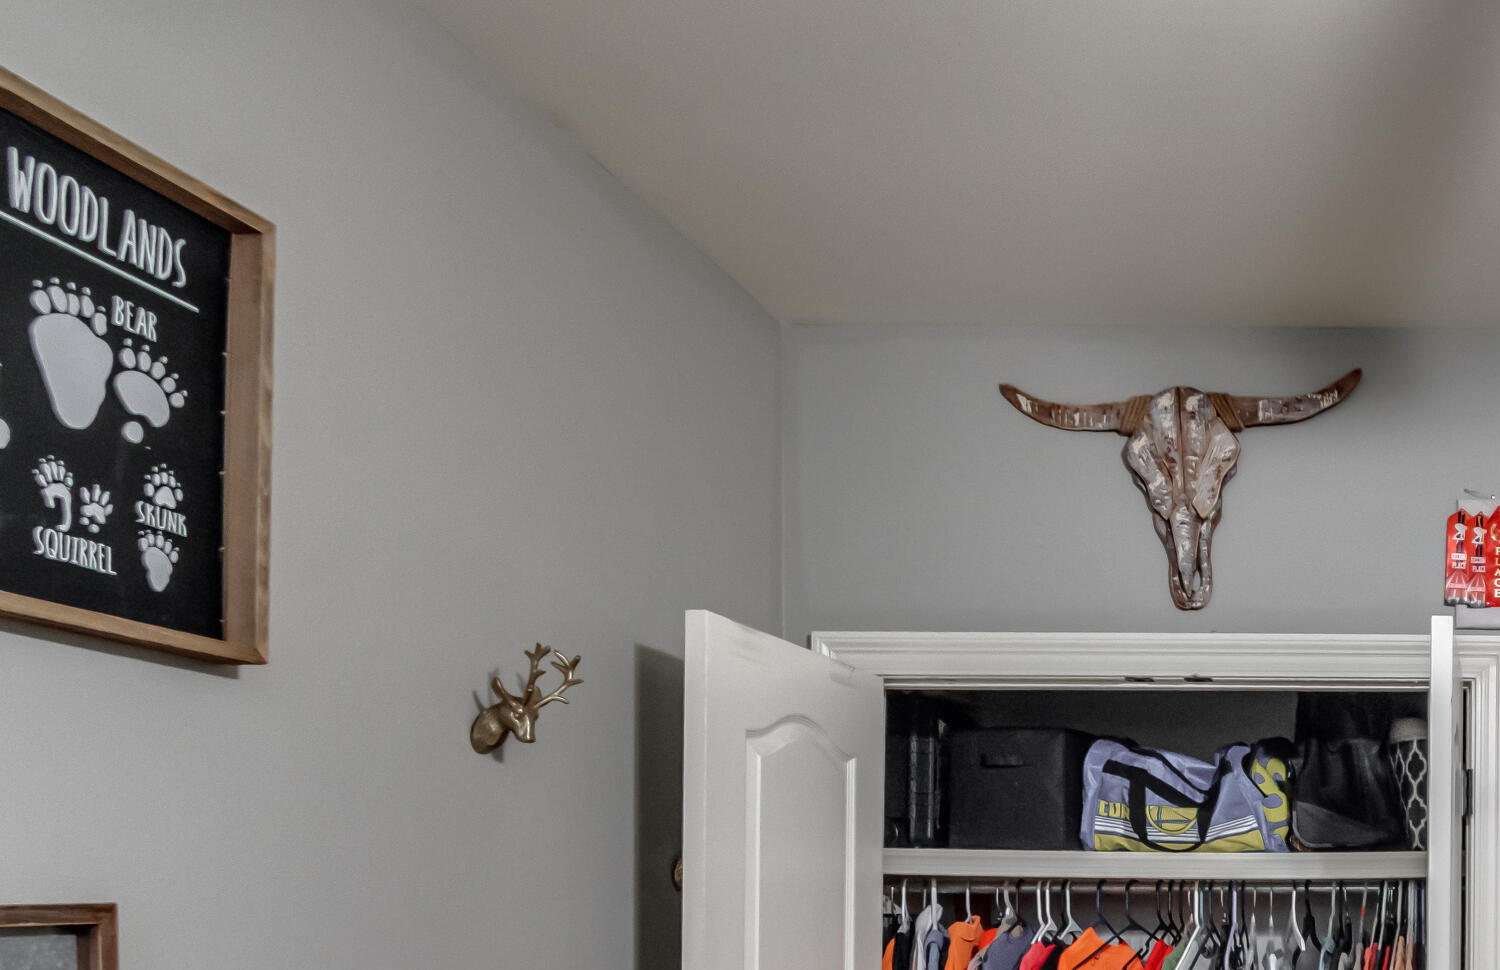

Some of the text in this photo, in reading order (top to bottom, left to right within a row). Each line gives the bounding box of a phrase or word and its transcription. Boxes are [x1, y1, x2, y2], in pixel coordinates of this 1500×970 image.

[7, 146, 187, 288] WOODLANDS
[111, 295, 158, 343] BEAR
[134, 500, 188, 537] SKUNK
[32, 525, 118, 576] SQUIRREL
